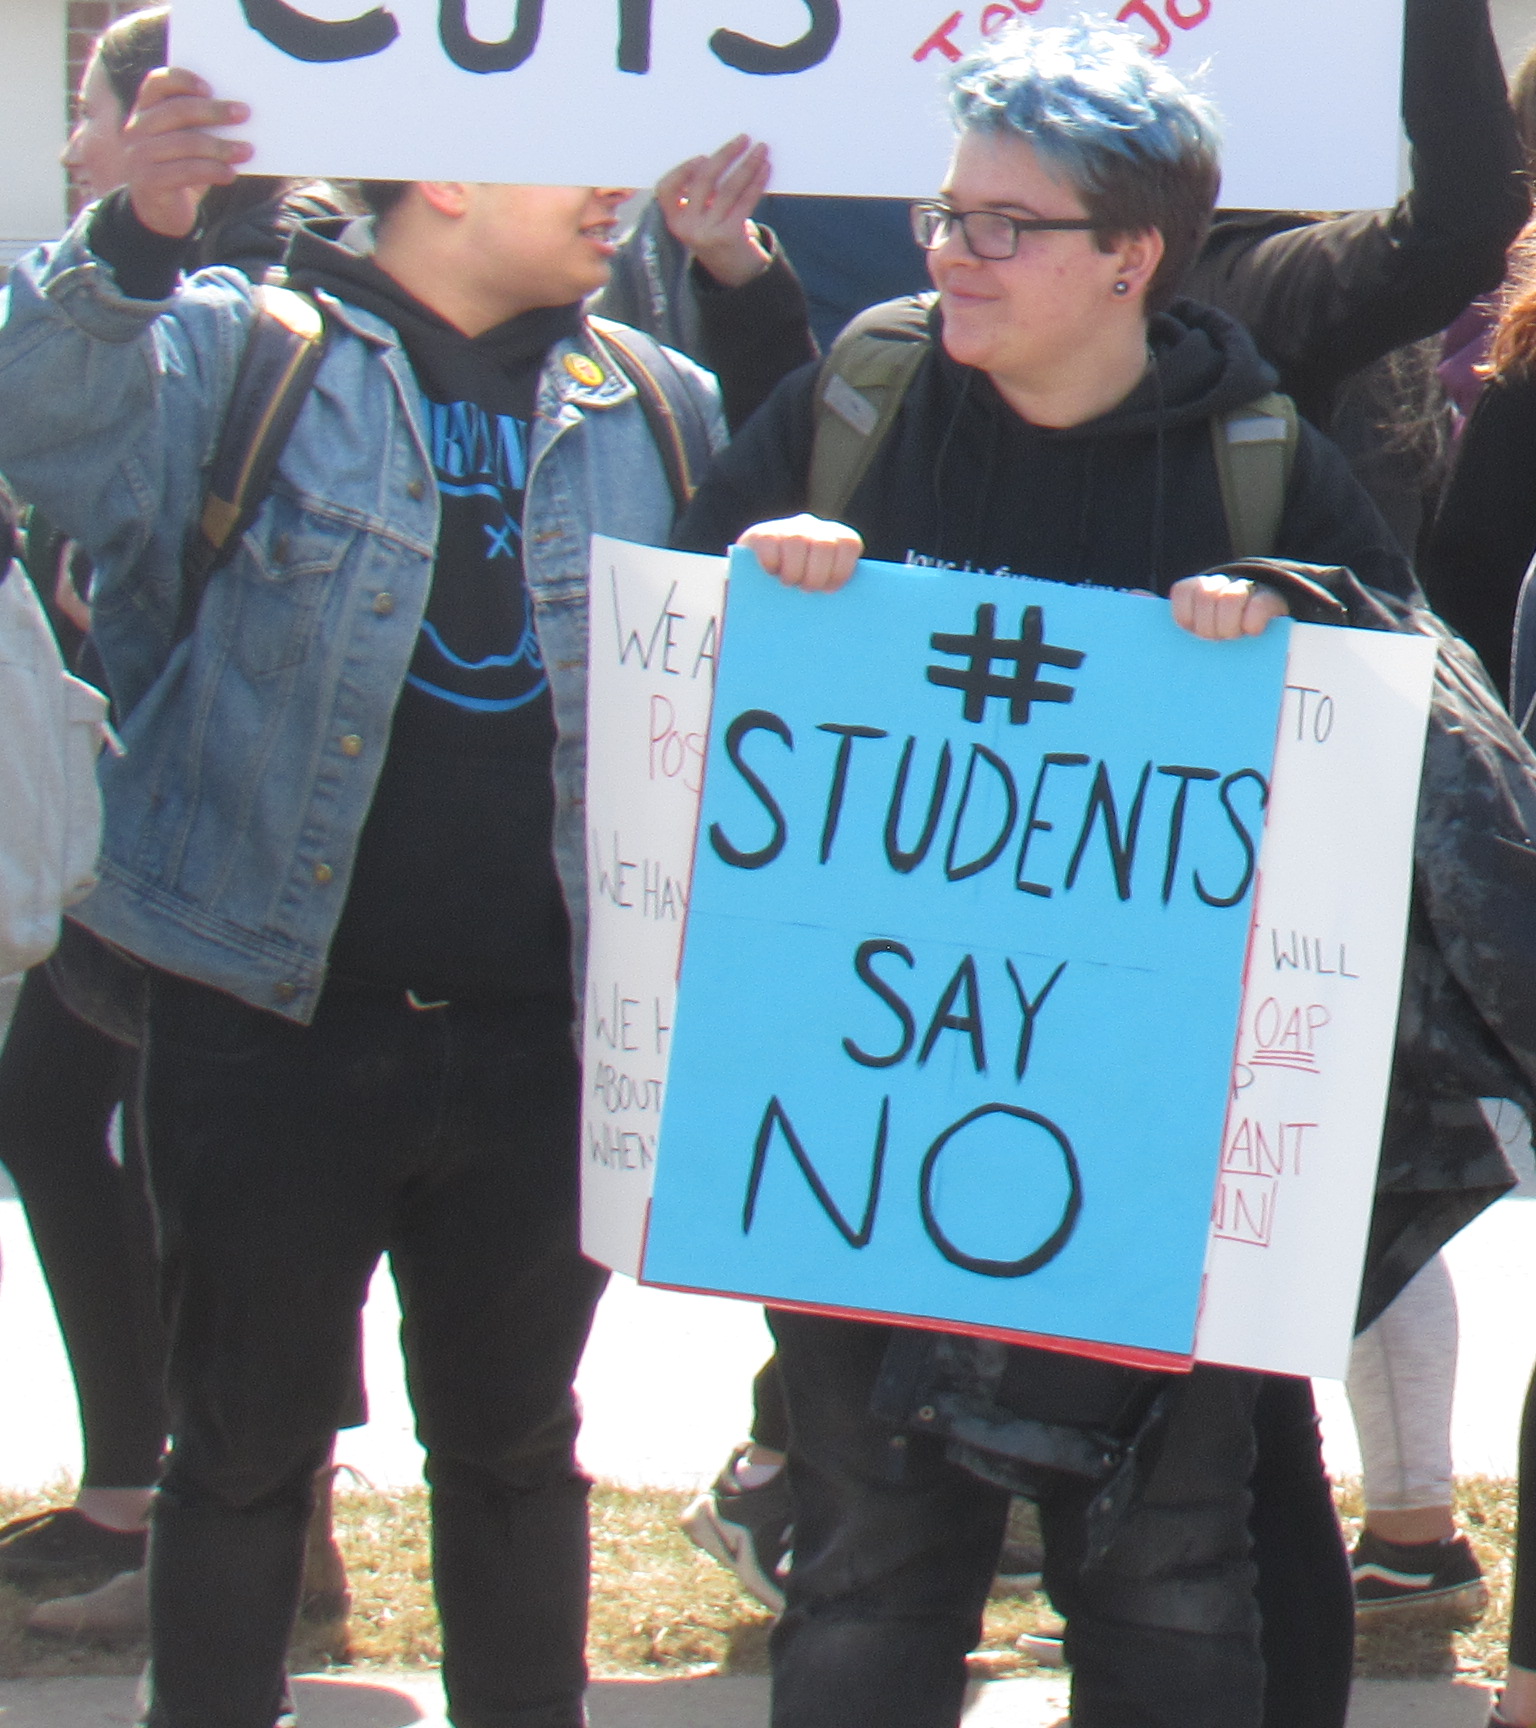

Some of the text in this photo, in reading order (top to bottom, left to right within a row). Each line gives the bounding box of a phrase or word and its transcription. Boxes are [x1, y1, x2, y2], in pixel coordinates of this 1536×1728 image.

[610, 564, 686, 675] WE
[925, 602, 1087, 726] #
[1284, 683, 1335, 743] TO
[708, 708, 1270, 909] STUDENTS
[592, 827, 638, 908] WE
[1271, 927, 1361, 979] WILL
[592, 981, 641, 1050] WE
[841, 939, 1067, 1083] SAY
[593, 1060, 663, 1114] ABOUT
[586, 1122, 657, 1170] WHEN
[742, 1095, 1083, 1279] NO
